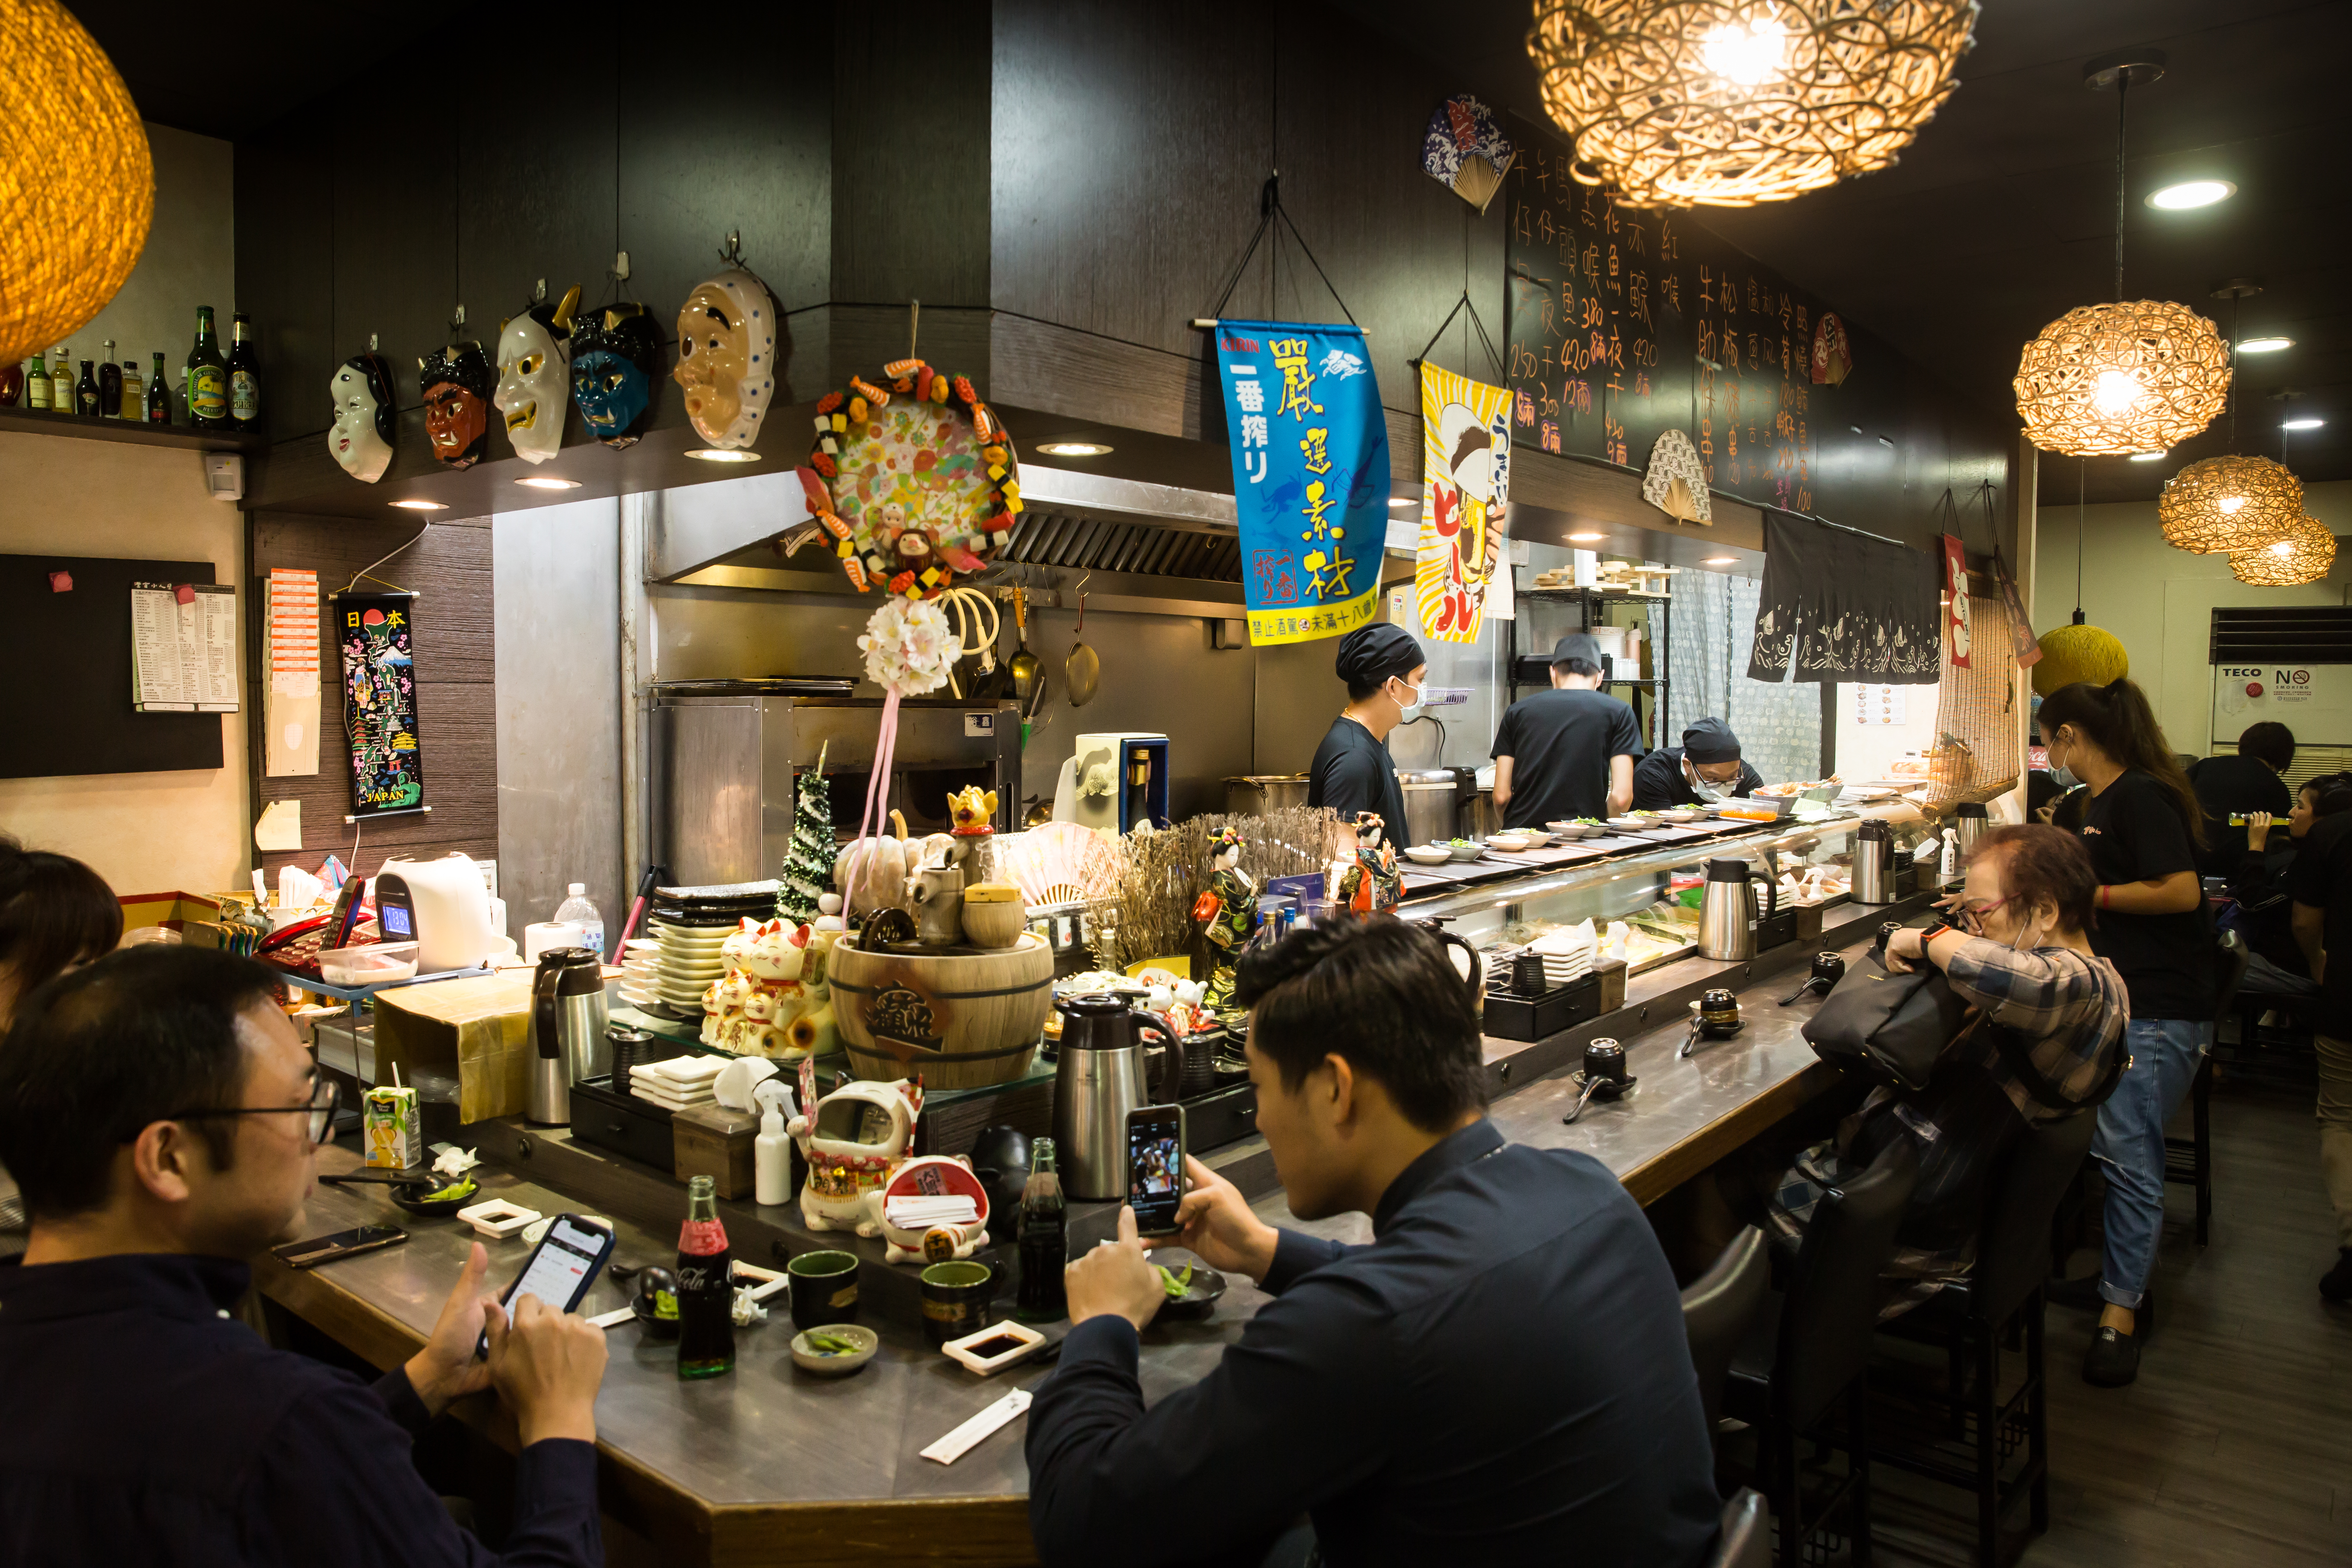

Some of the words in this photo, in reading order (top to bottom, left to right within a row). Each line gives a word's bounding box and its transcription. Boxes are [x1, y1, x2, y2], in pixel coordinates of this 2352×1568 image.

[1581, 297, 1603, 328] 380
[1221, 337, 1260, 354] KIRIN
[1561, 339, 1589, 373] 420
[1634, 338, 1657, 366] 420
[1511, 340, 1537, 379] 250
[194, 372, 203, 399] PREMIUM
[1540, 382, 1559, 416] 300
[1779, 381, 1794, 408] 180
[1229, 364, 1268, 483] 一番搾り
[1267, 337, 1355, 600] 嚴選素材
[1797, 486, 1811, 511] 100
[1252, 617, 1299, 638] 禁止酒駕
[2223, 668, 2262, 677] TECO
[368, 791, 404, 803] JAPAN
